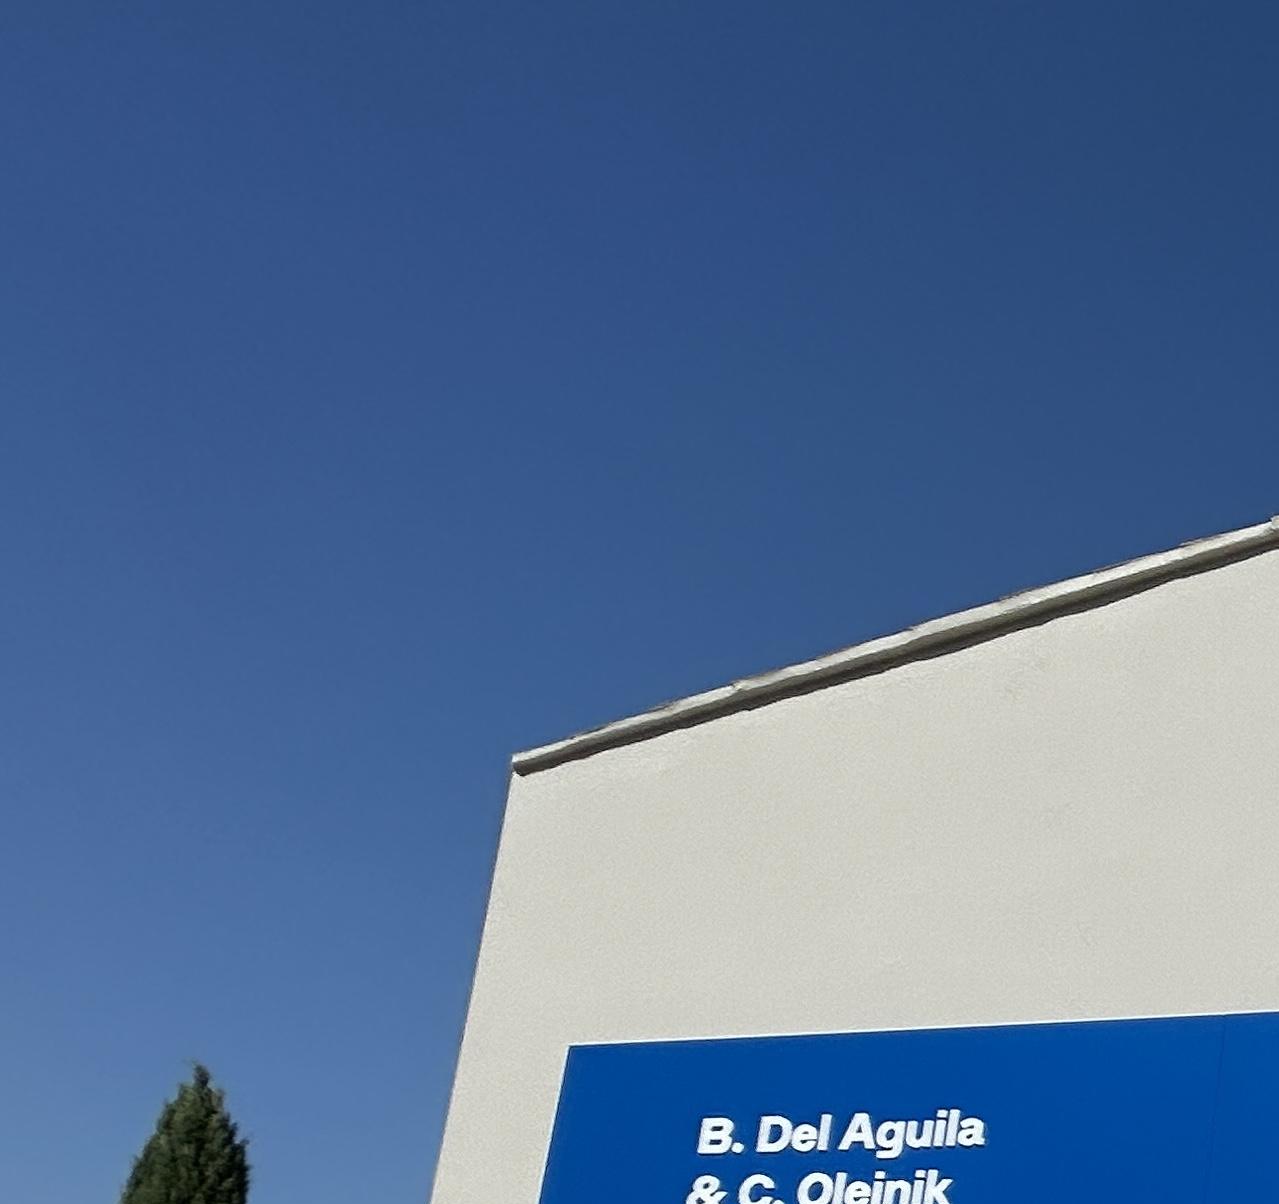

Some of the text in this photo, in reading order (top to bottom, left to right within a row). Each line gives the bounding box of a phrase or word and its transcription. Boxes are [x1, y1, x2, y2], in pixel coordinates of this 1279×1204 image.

[697, 1109, 986, 1160] B. Del Aguila
